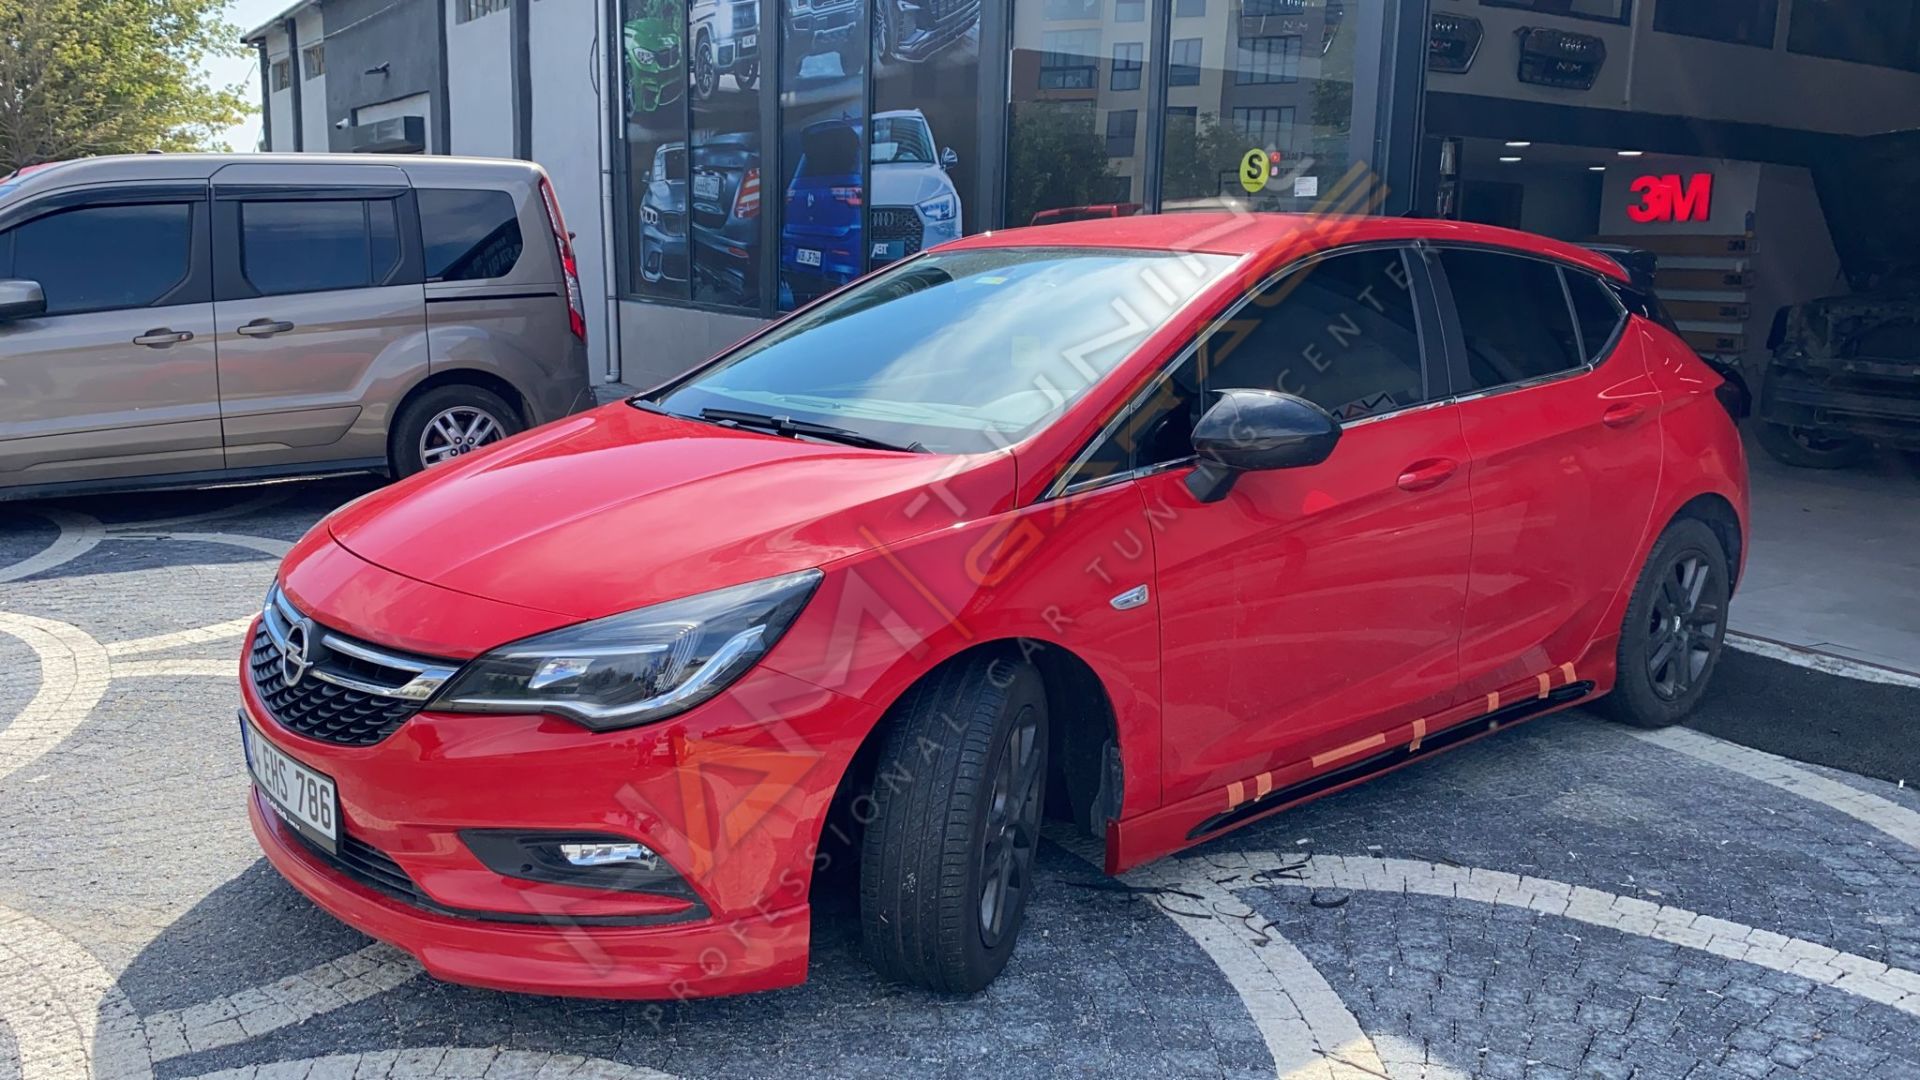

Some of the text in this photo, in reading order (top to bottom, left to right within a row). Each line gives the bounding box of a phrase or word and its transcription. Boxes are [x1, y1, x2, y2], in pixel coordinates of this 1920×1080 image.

[1247, 154, 1262, 179] S
[1627, 174, 1713, 223] 3M
[263, 744, 288, 802] EHS
[296, 770, 332, 830] 786
